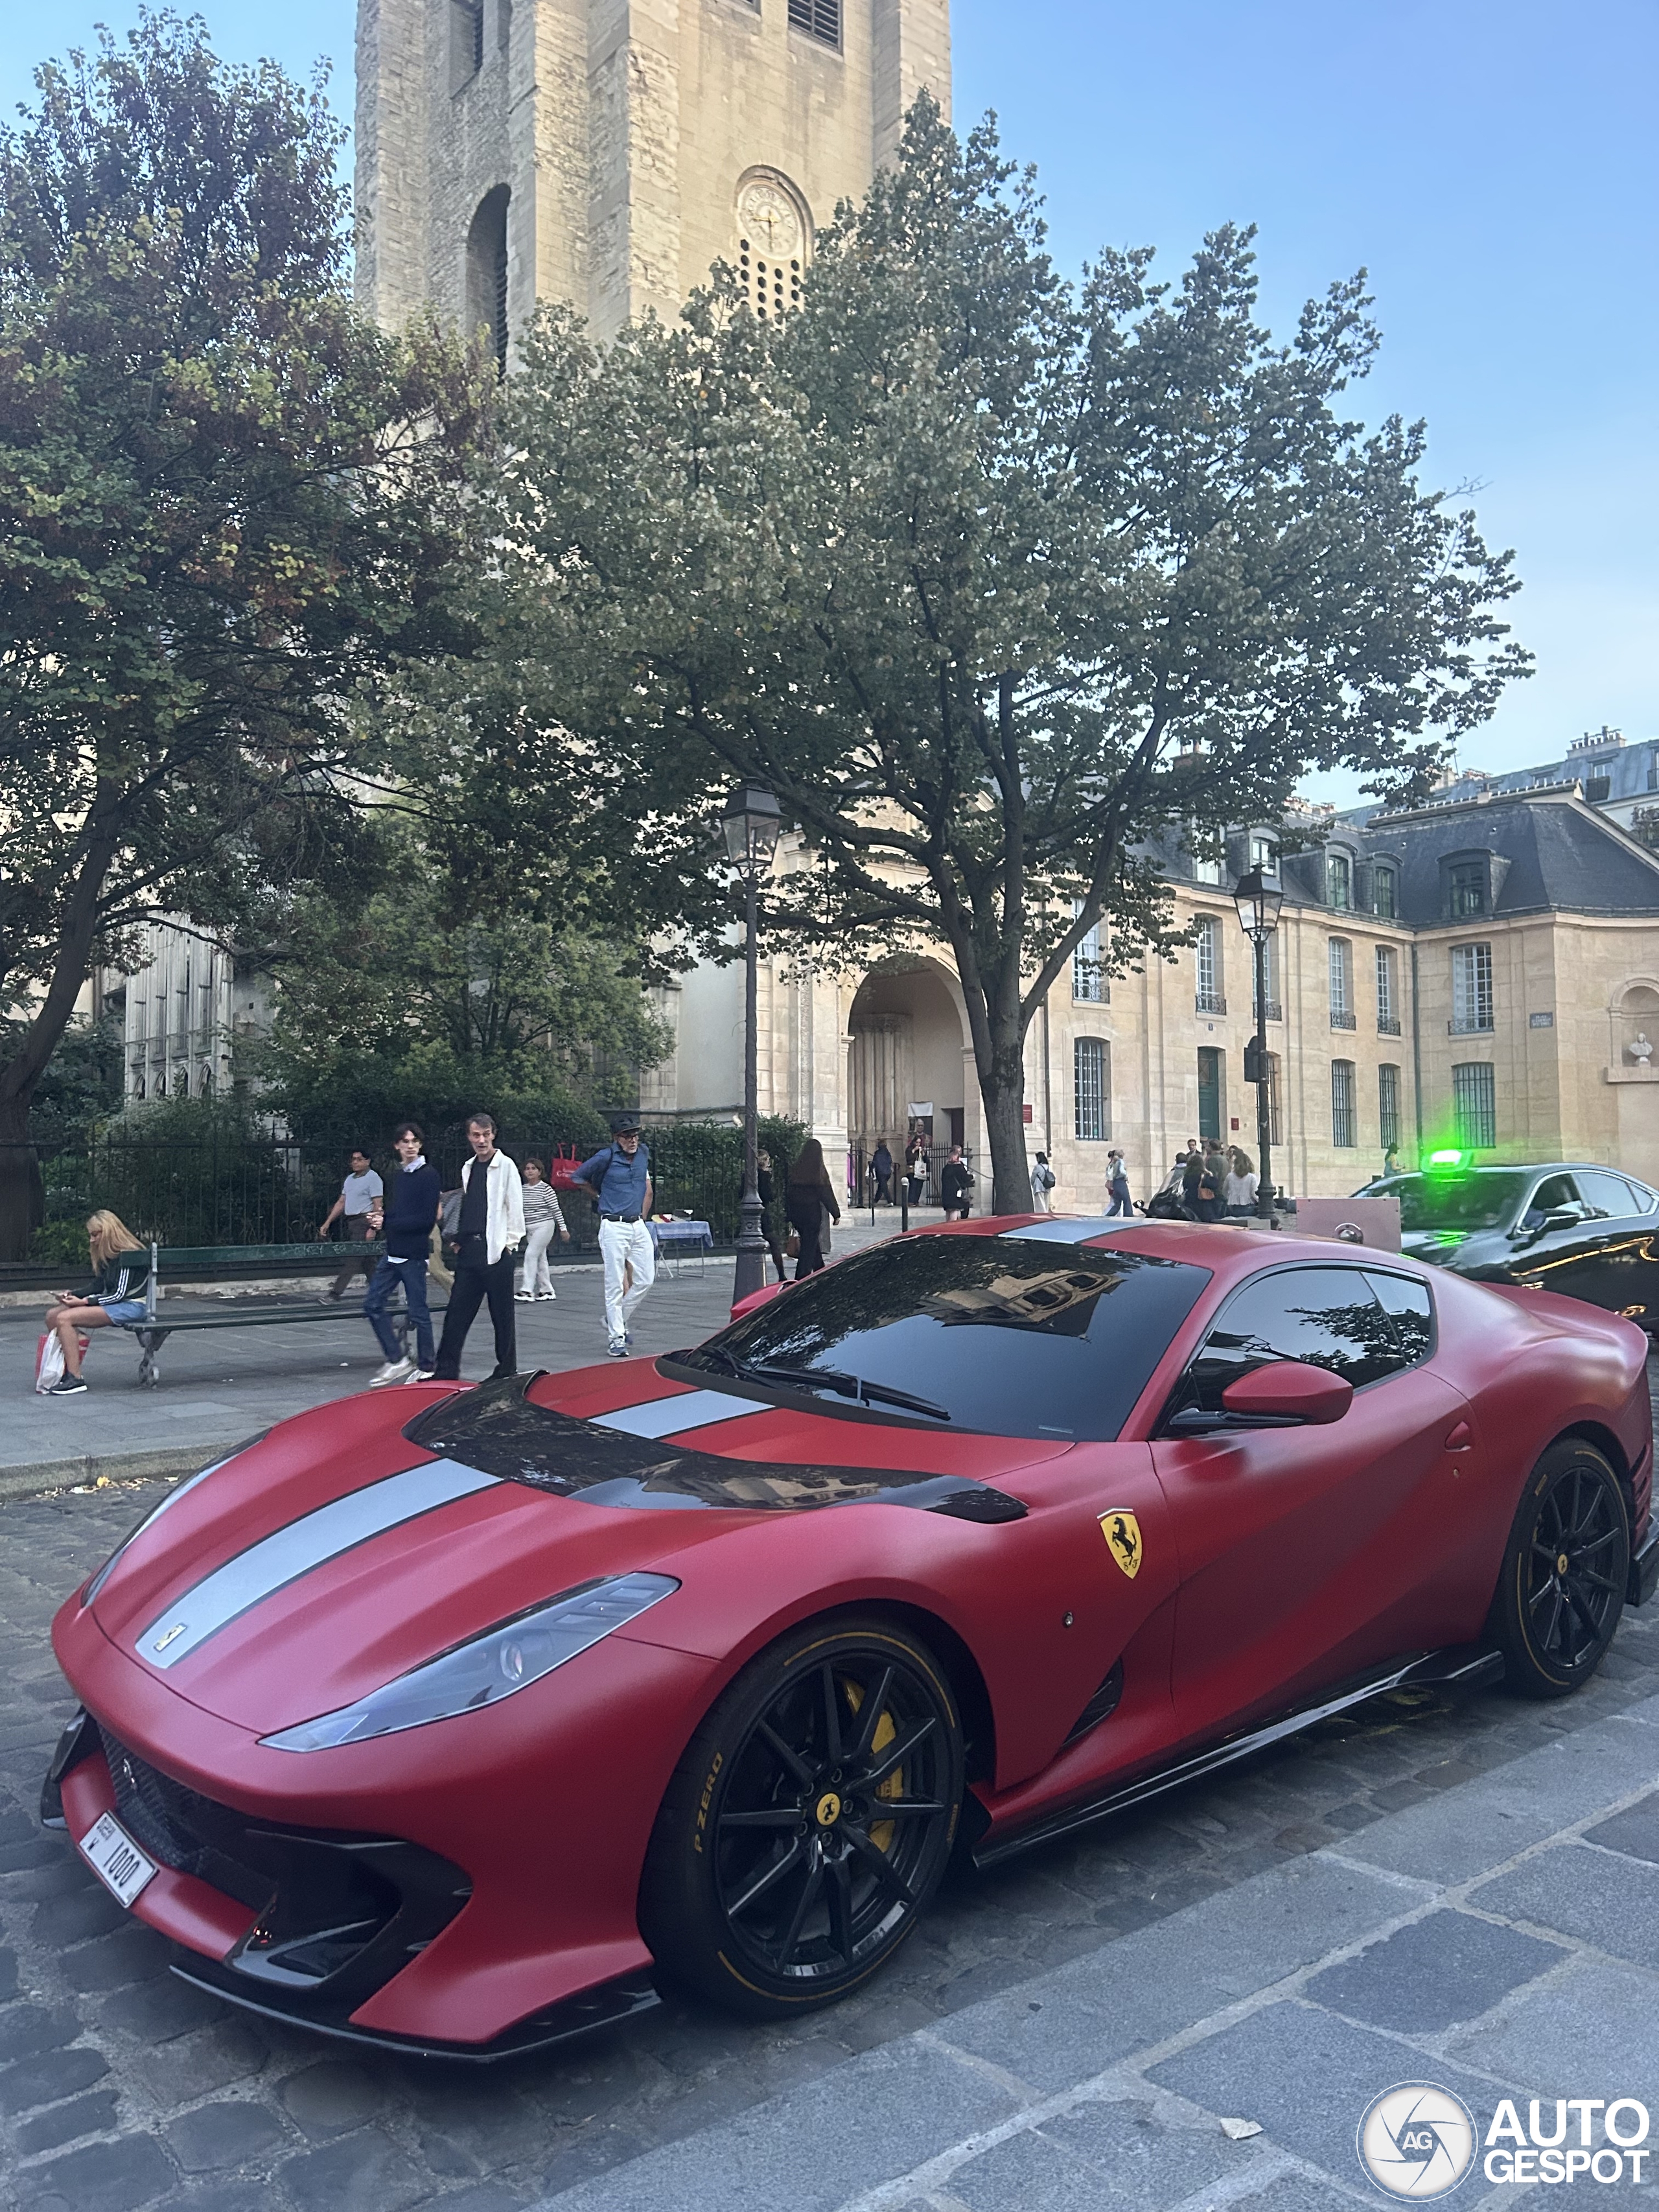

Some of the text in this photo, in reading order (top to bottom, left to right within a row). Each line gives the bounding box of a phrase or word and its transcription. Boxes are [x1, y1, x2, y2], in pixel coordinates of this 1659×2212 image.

[695, 1752, 723, 1853] P ZERO
[104, 1841, 140, 1887] 1000
